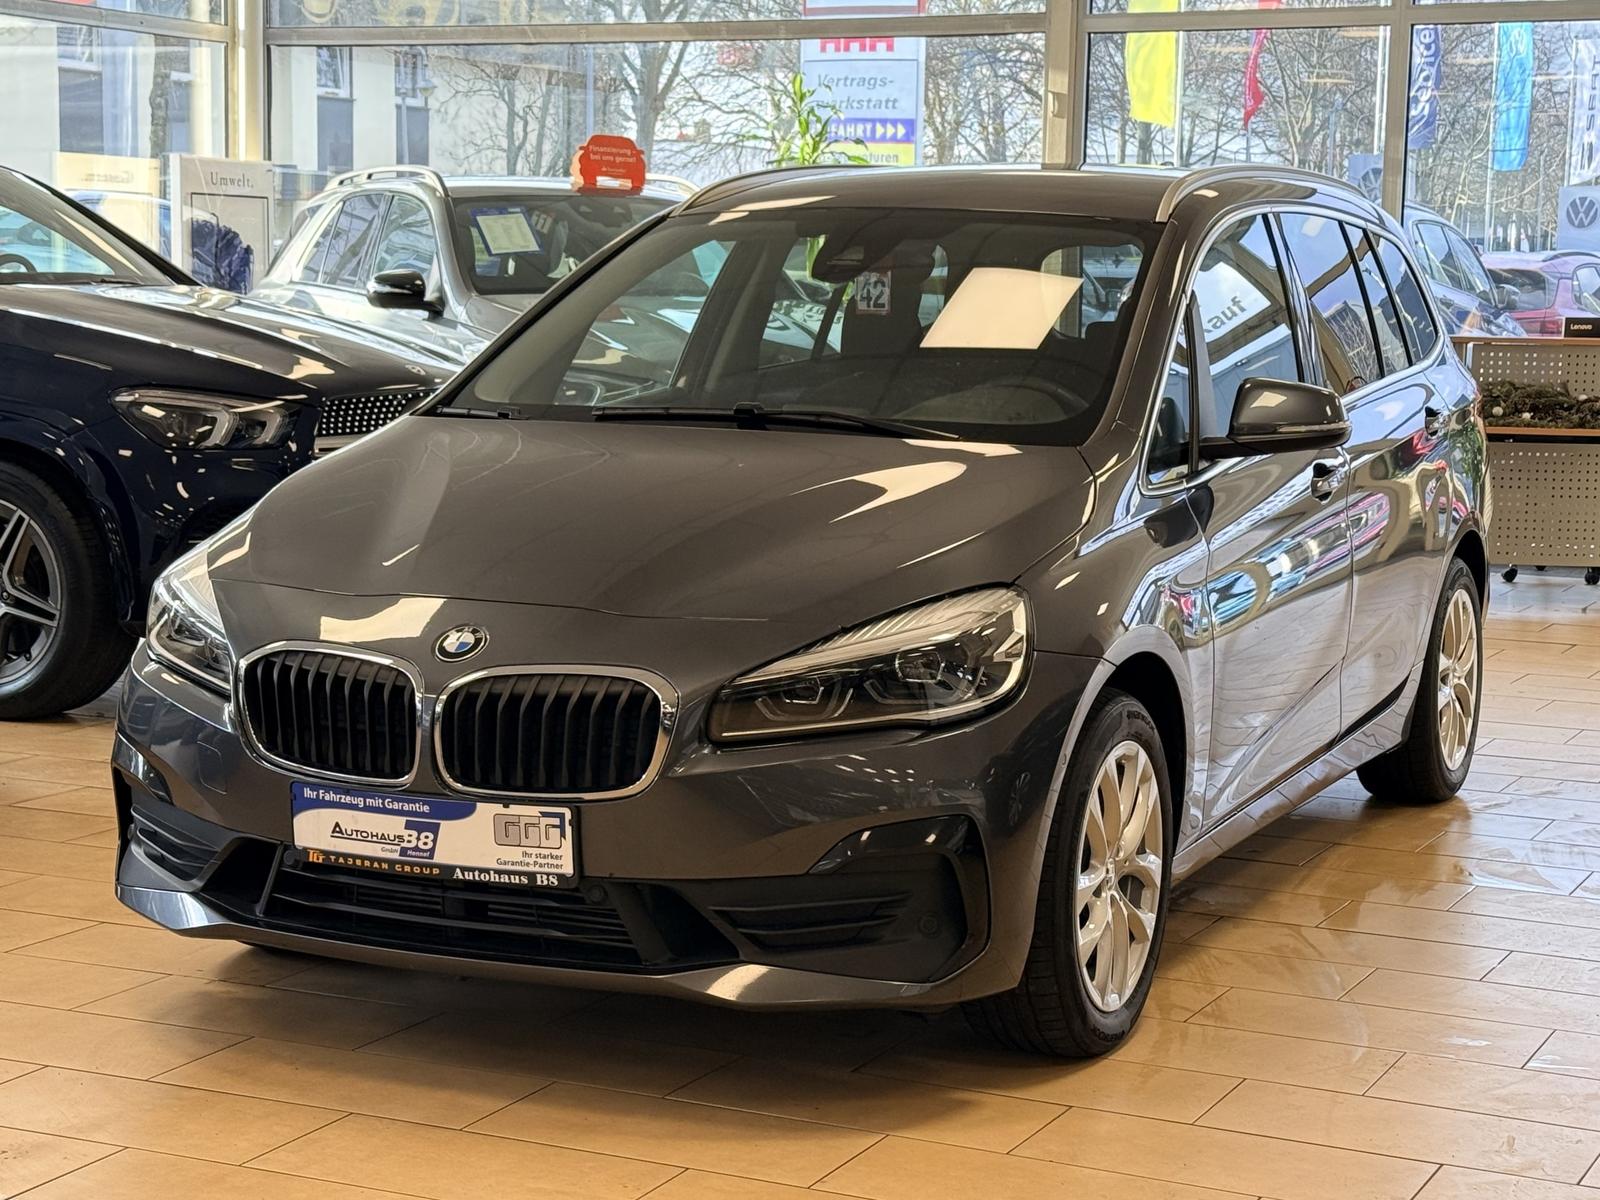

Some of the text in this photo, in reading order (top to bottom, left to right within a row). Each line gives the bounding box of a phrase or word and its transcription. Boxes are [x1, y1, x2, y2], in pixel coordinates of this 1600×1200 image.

[1586, 55, 1600, 132] SEAT
[816, 96, 899, 111] rkstatt
[210, 171, 255, 189] Umwelt.
[1203, 295, 1248, 335] auf
[1570, 323, 1593, 331] Lenovo
[303, 787, 430, 813] Ihr Fahrzeug mit Garantie
[406, 849, 431, 858] Hennef
[521, 850, 563, 861] Ihr starker
[394, 863, 440, 875] GROUP
[496, 857, 563, 870] Garantie-Partner
[452, 867, 558, 886] Autohaus B8
